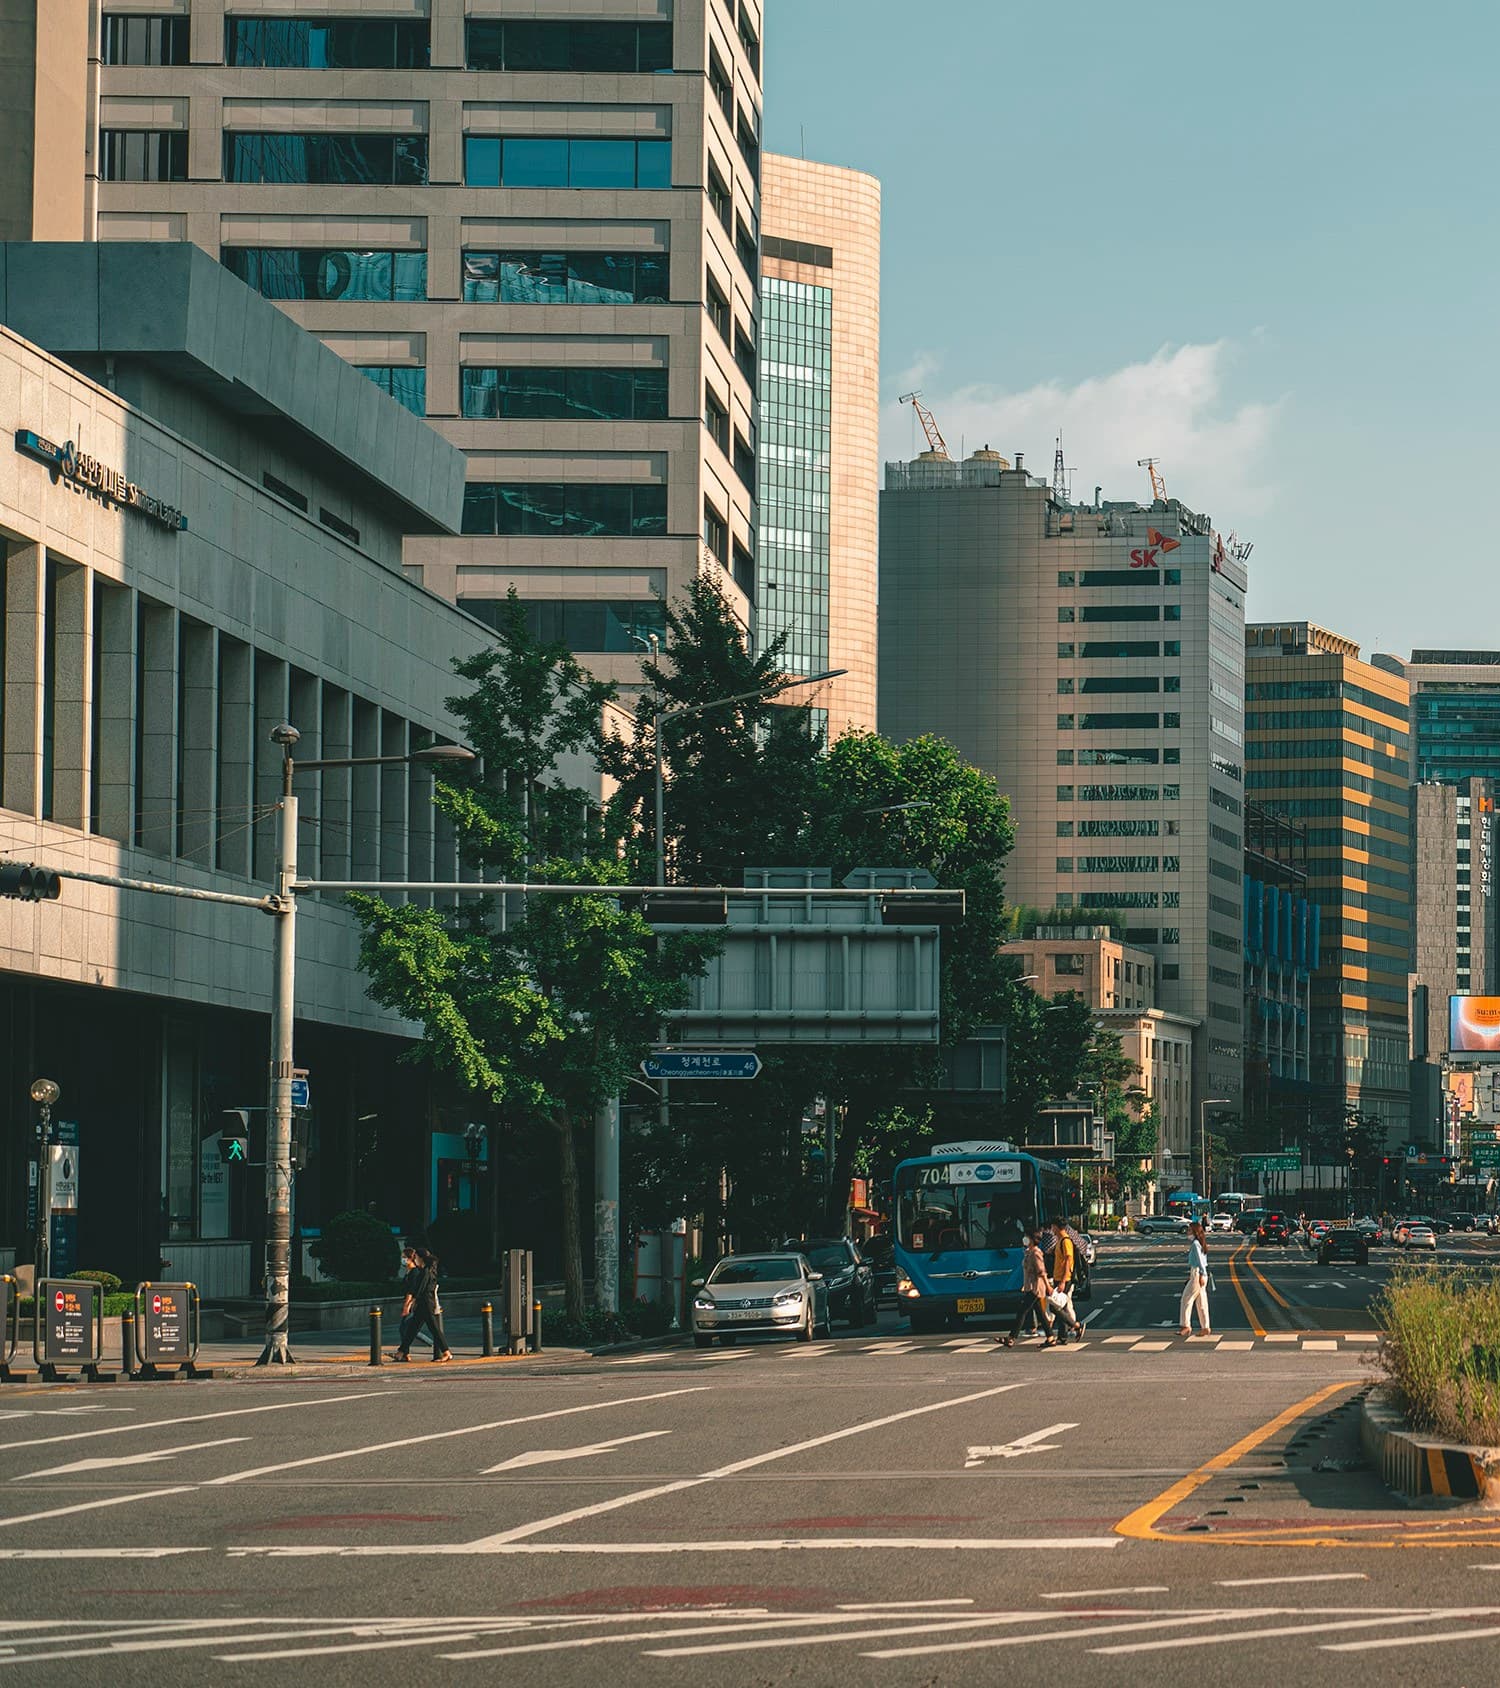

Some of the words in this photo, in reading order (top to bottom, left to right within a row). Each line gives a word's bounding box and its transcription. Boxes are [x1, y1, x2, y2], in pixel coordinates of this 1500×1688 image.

[77, 452, 127, 502] 신한캐피탈
[1130, 549, 1158, 568] SK
[1480, 816, 1491, 897] 현대해상화재
[681, 1056, 722, 1068] 청계천로
[744, 1062, 755, 1070] 46
[921, 1166, 950, 1185] 704
